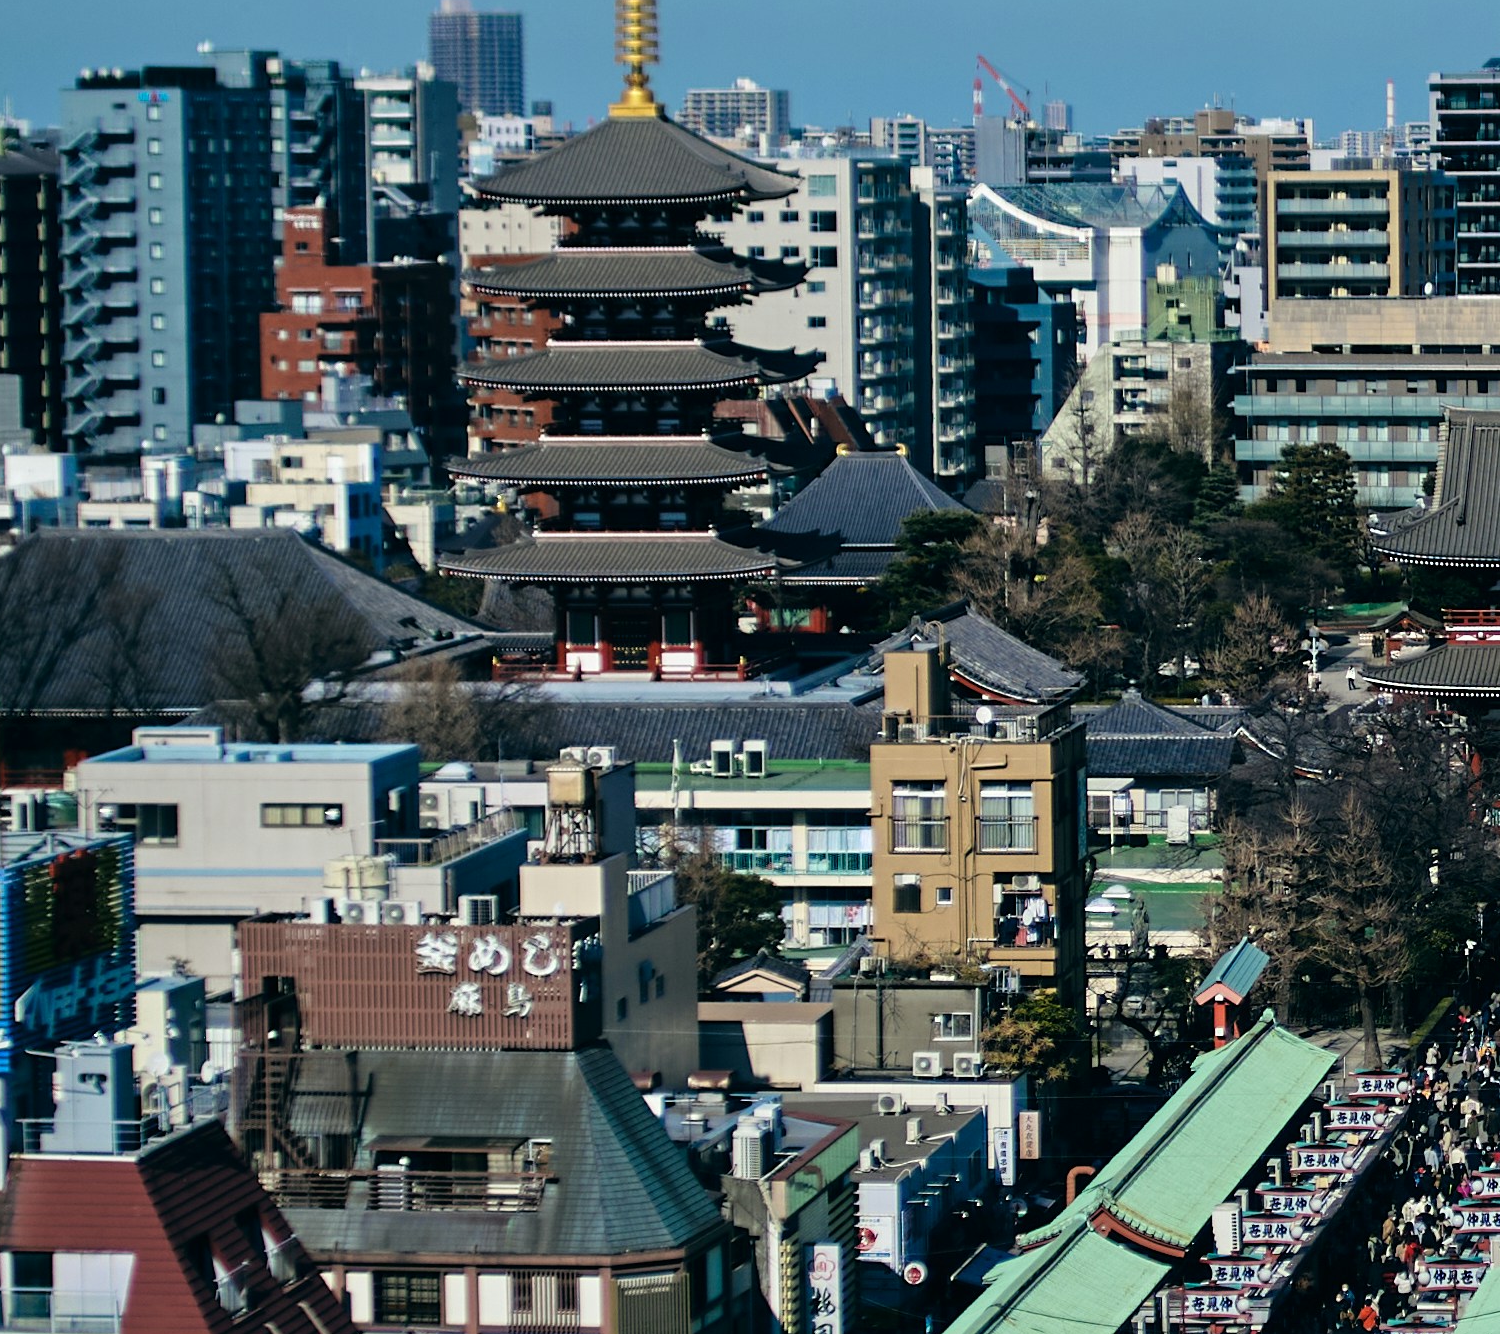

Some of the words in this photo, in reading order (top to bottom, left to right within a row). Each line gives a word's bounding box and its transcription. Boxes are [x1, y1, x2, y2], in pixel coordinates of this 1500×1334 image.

[414, 932, 559, 977] 釜めし
[447, 981, 533, 1018] 麻鳥
